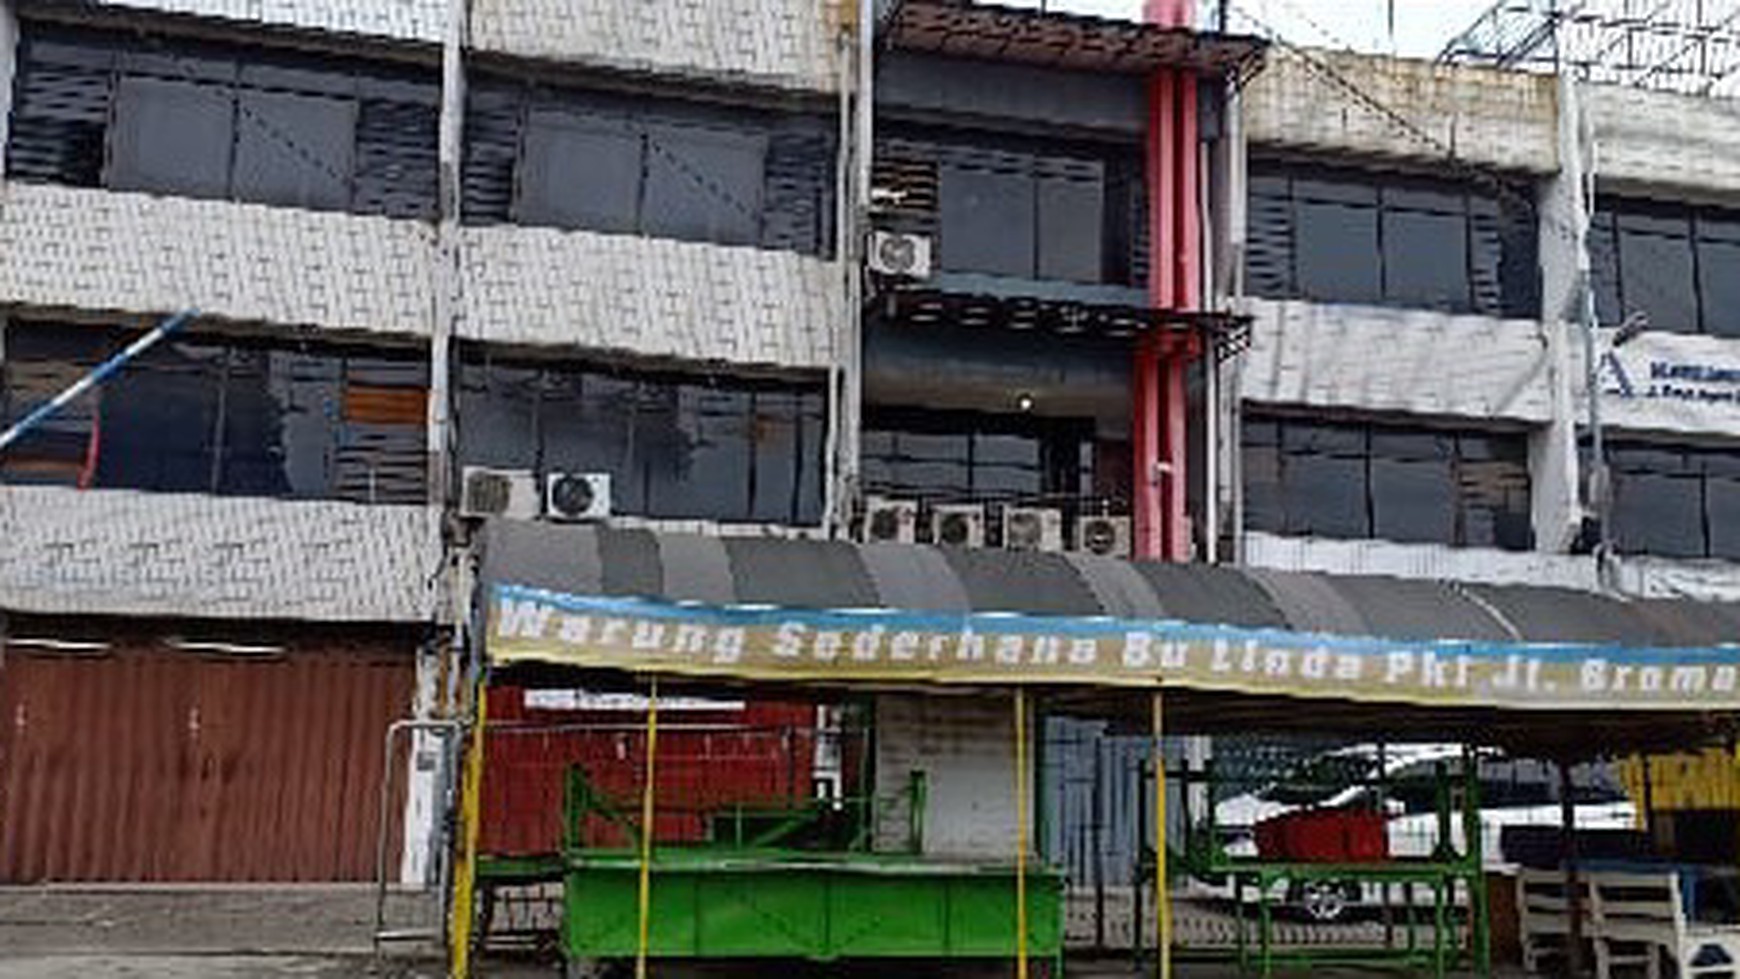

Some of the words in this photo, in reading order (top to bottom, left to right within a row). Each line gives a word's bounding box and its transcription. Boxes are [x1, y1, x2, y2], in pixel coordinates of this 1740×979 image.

[497, 597, 747, 663] Warung
[773, 621, 1098, 664] Sederhana
[1122, 631, 1188, 668] Bu
[1211, 637, 1361, 679] Linda
[1580, 658, 1738, 691] Bromo
